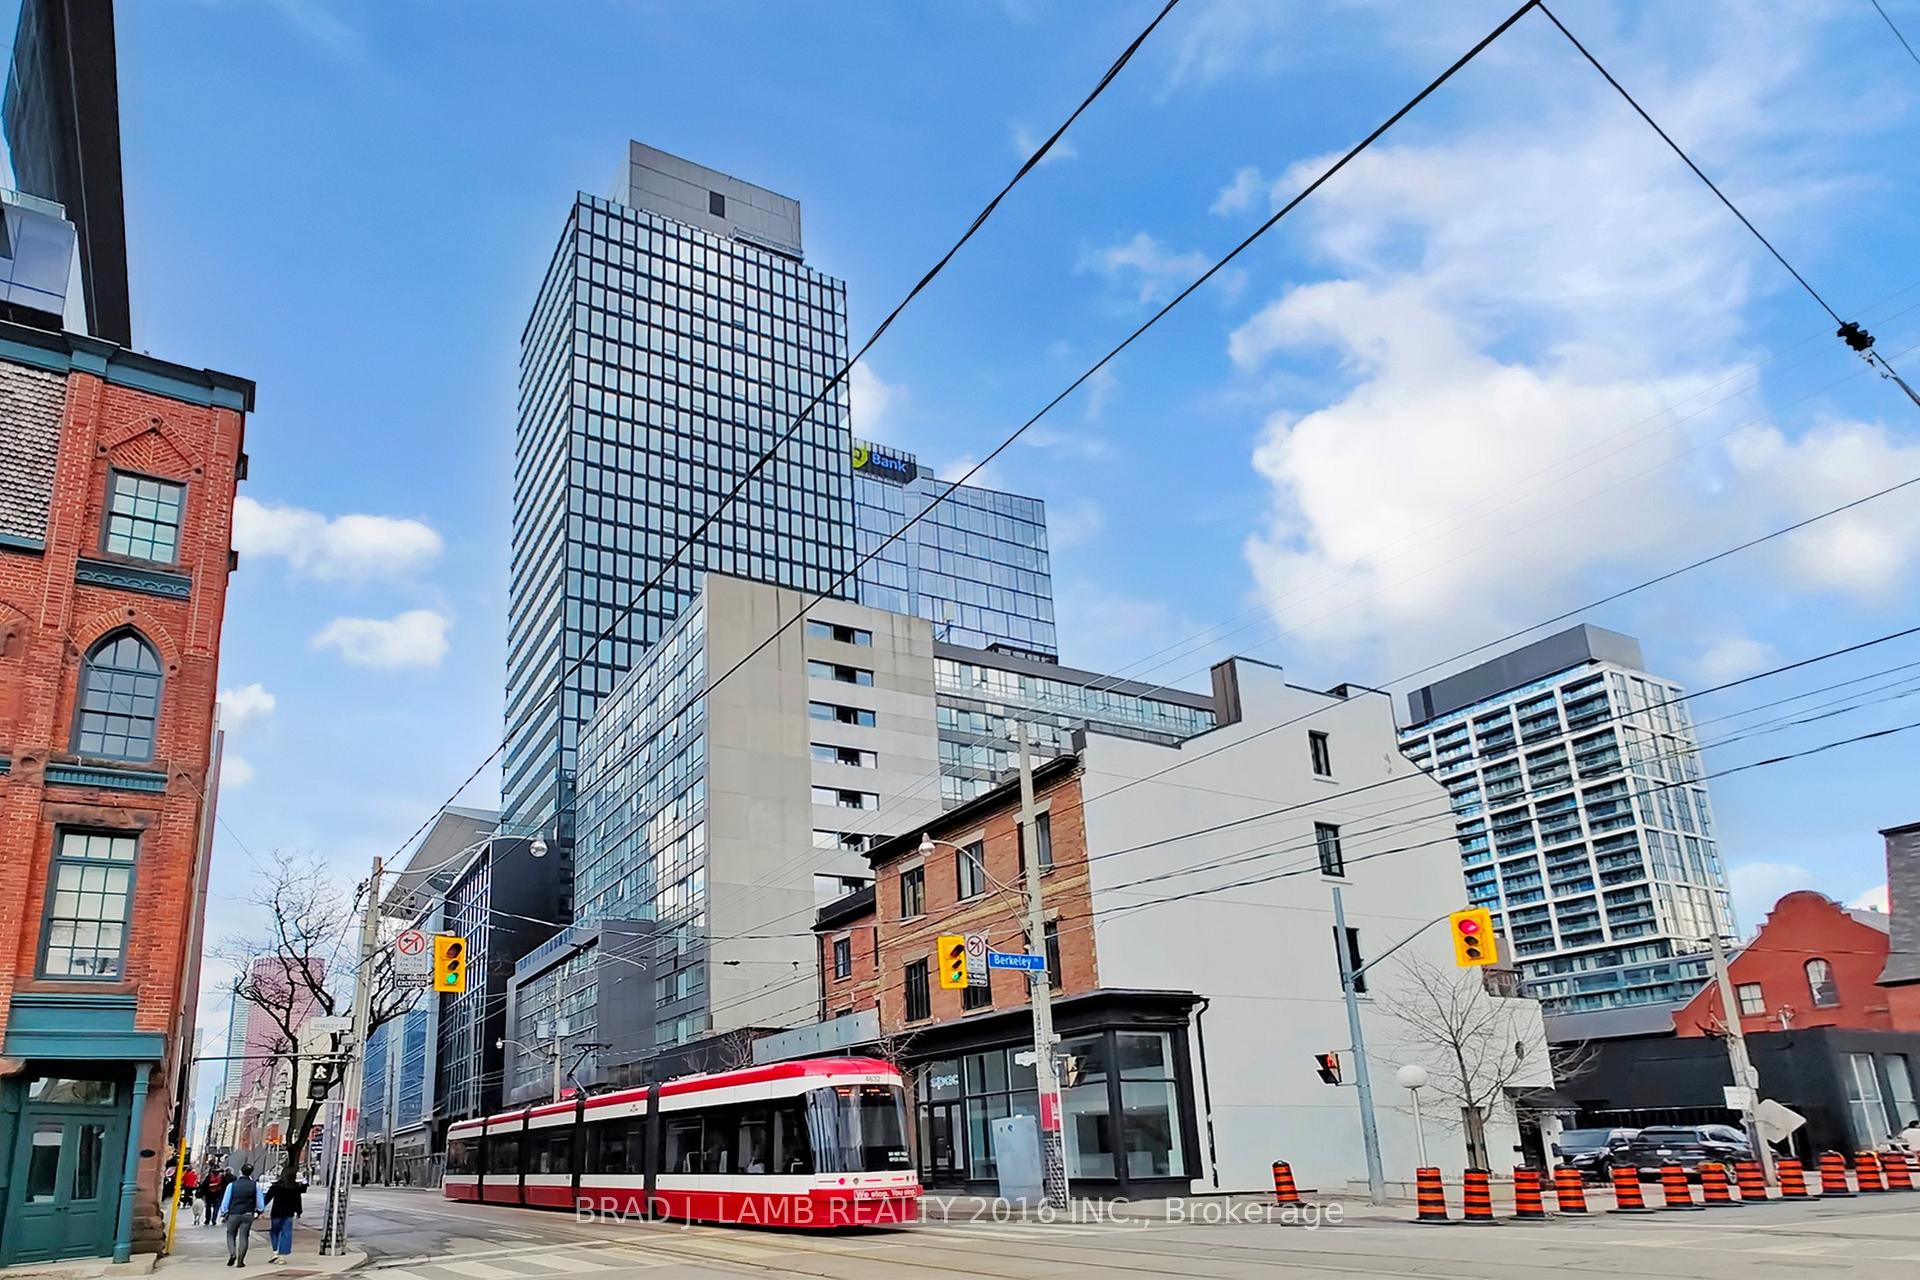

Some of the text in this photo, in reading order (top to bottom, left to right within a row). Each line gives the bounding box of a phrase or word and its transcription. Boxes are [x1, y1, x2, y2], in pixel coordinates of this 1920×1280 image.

[872, 452, 907, 473] Bank
[993, 954, 1031, 969] Berkeley
[855, 1190, 869, 1198] We
[891, 1189, 903, 1197] You
